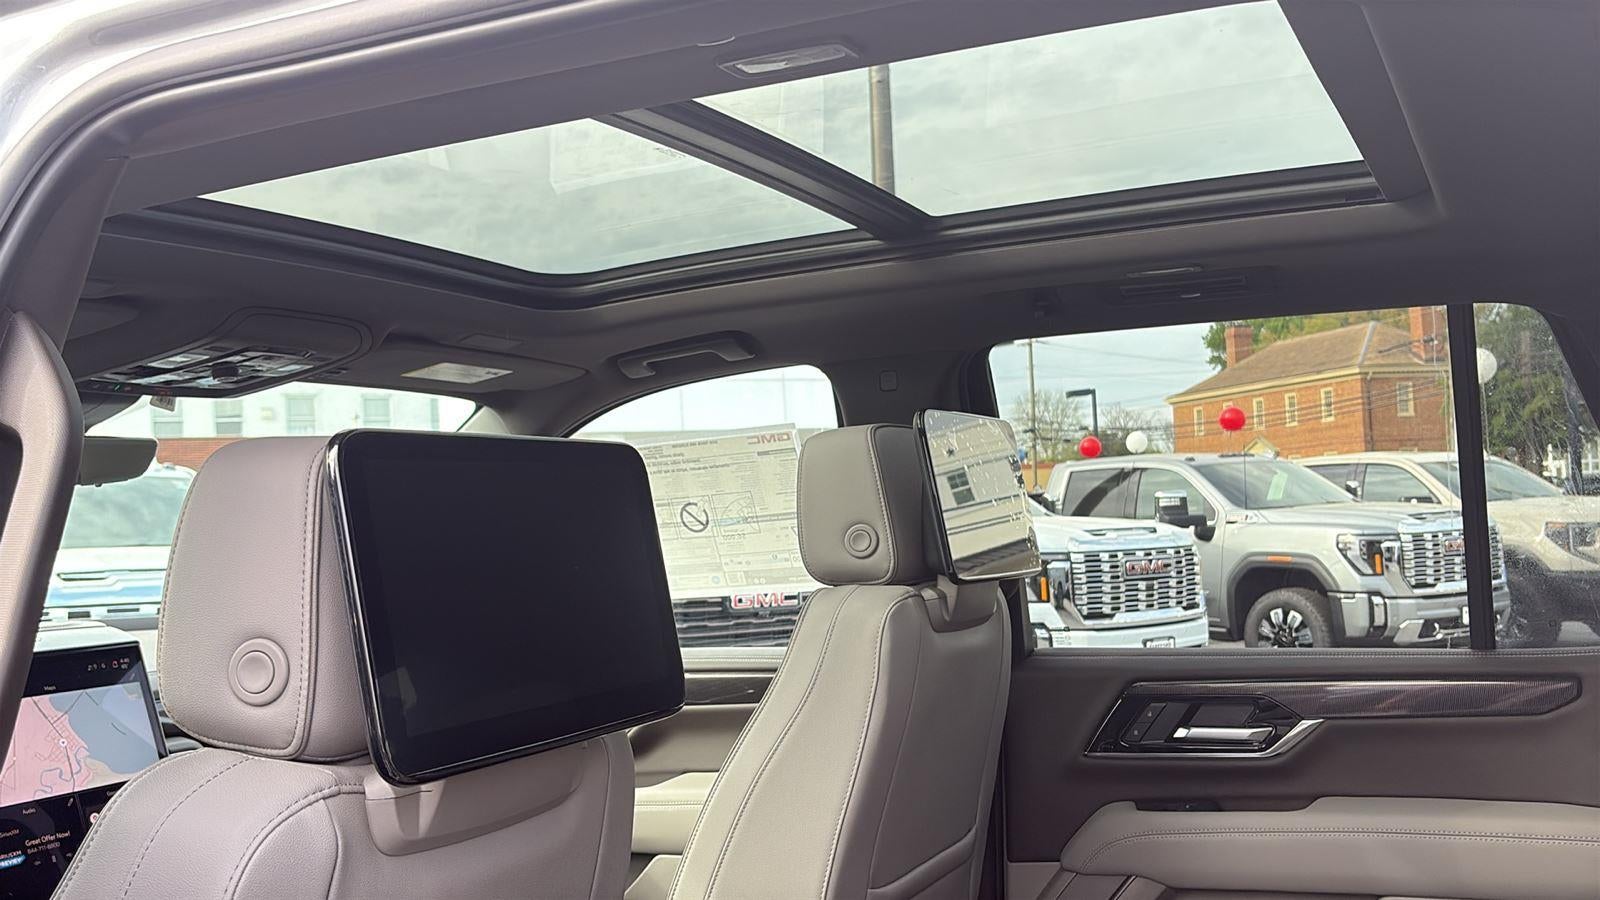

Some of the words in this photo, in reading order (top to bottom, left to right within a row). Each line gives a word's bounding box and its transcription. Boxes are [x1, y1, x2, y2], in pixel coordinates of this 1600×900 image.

[1126, 559, 1171, 576] GMC
[732, 592, 798, 609] GMC
[25, 838, 41, 847] Great
[41, 834, 56, 842] Offer
